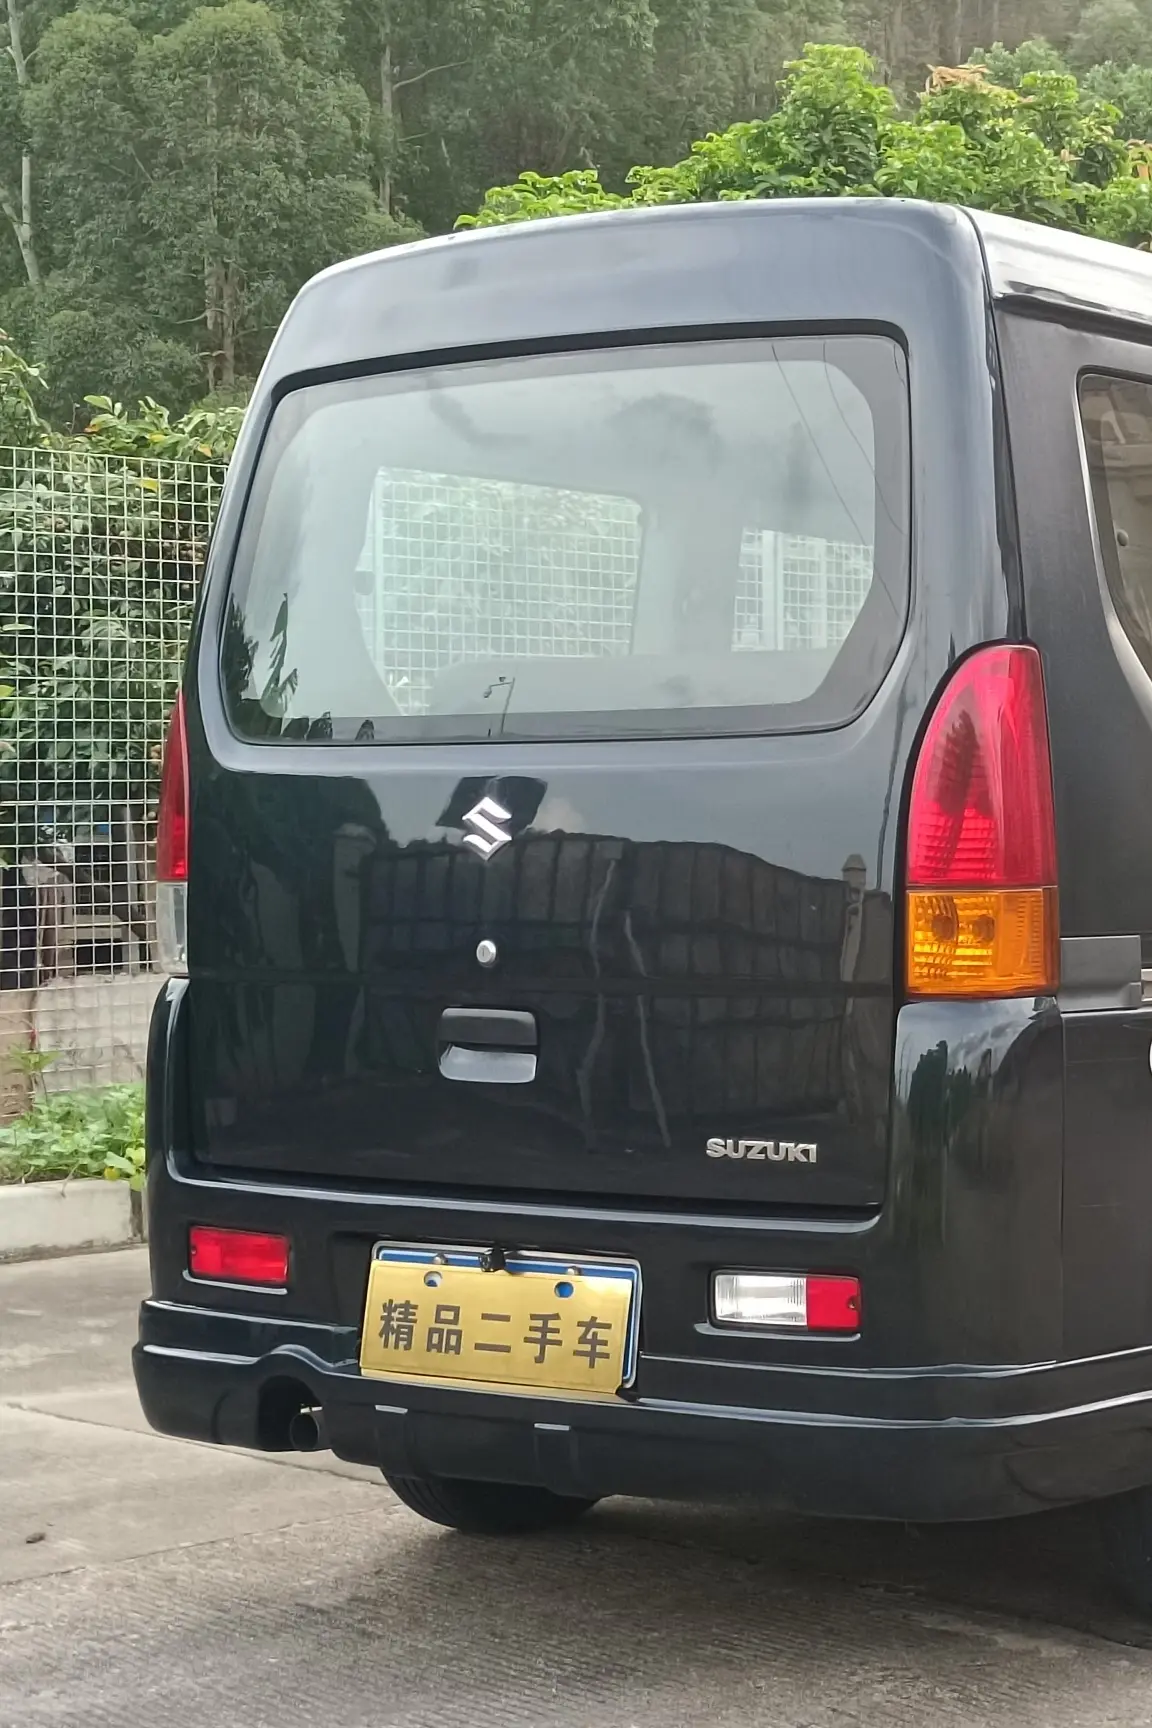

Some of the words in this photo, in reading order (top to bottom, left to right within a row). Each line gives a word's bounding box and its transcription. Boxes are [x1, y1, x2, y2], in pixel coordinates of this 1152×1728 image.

[705, 1137, 818, 1163] SUZUKI
[378, 1298, 613, 1369] 精品二手车
